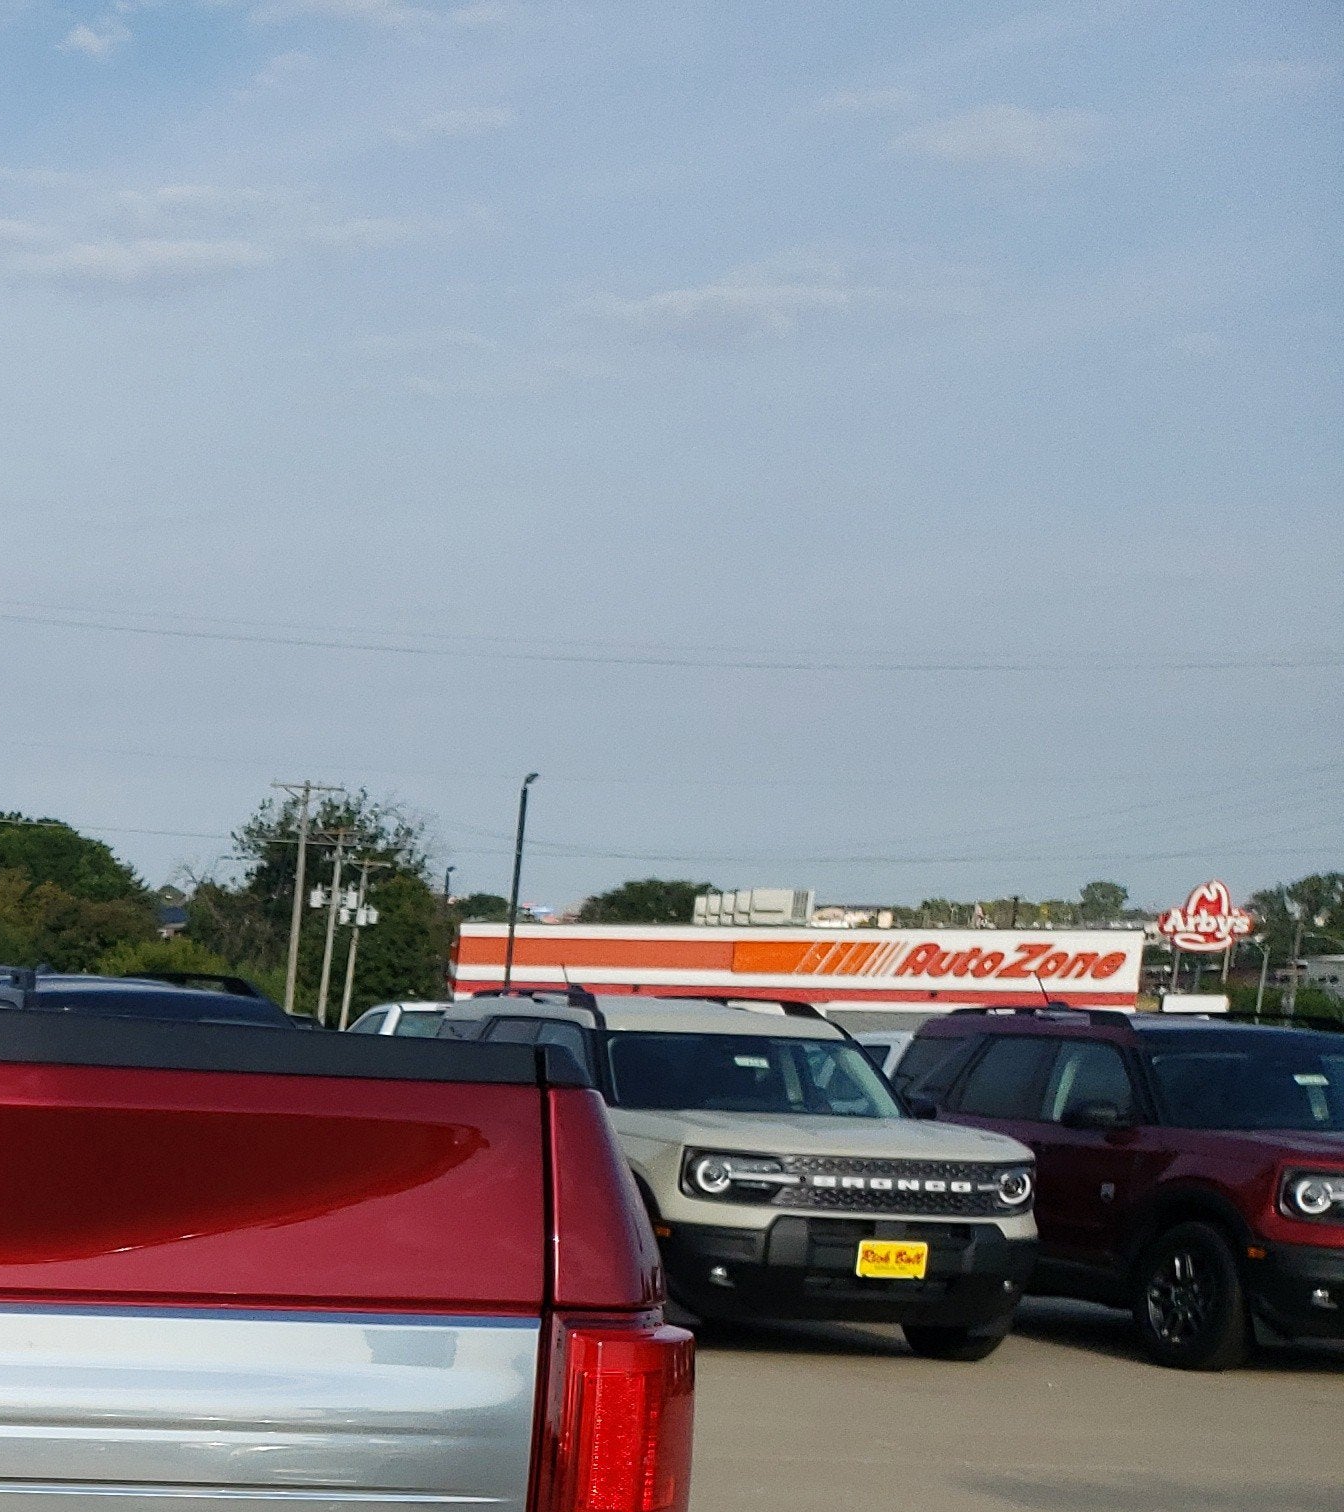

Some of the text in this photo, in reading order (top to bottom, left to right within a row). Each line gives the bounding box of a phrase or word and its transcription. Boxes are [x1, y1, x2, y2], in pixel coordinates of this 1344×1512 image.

[1163, 908, 1250, 938] Arby's
[895, 942, 1127, 979] AutoZone
[812, 1175, 971, 1193] BRONCO
